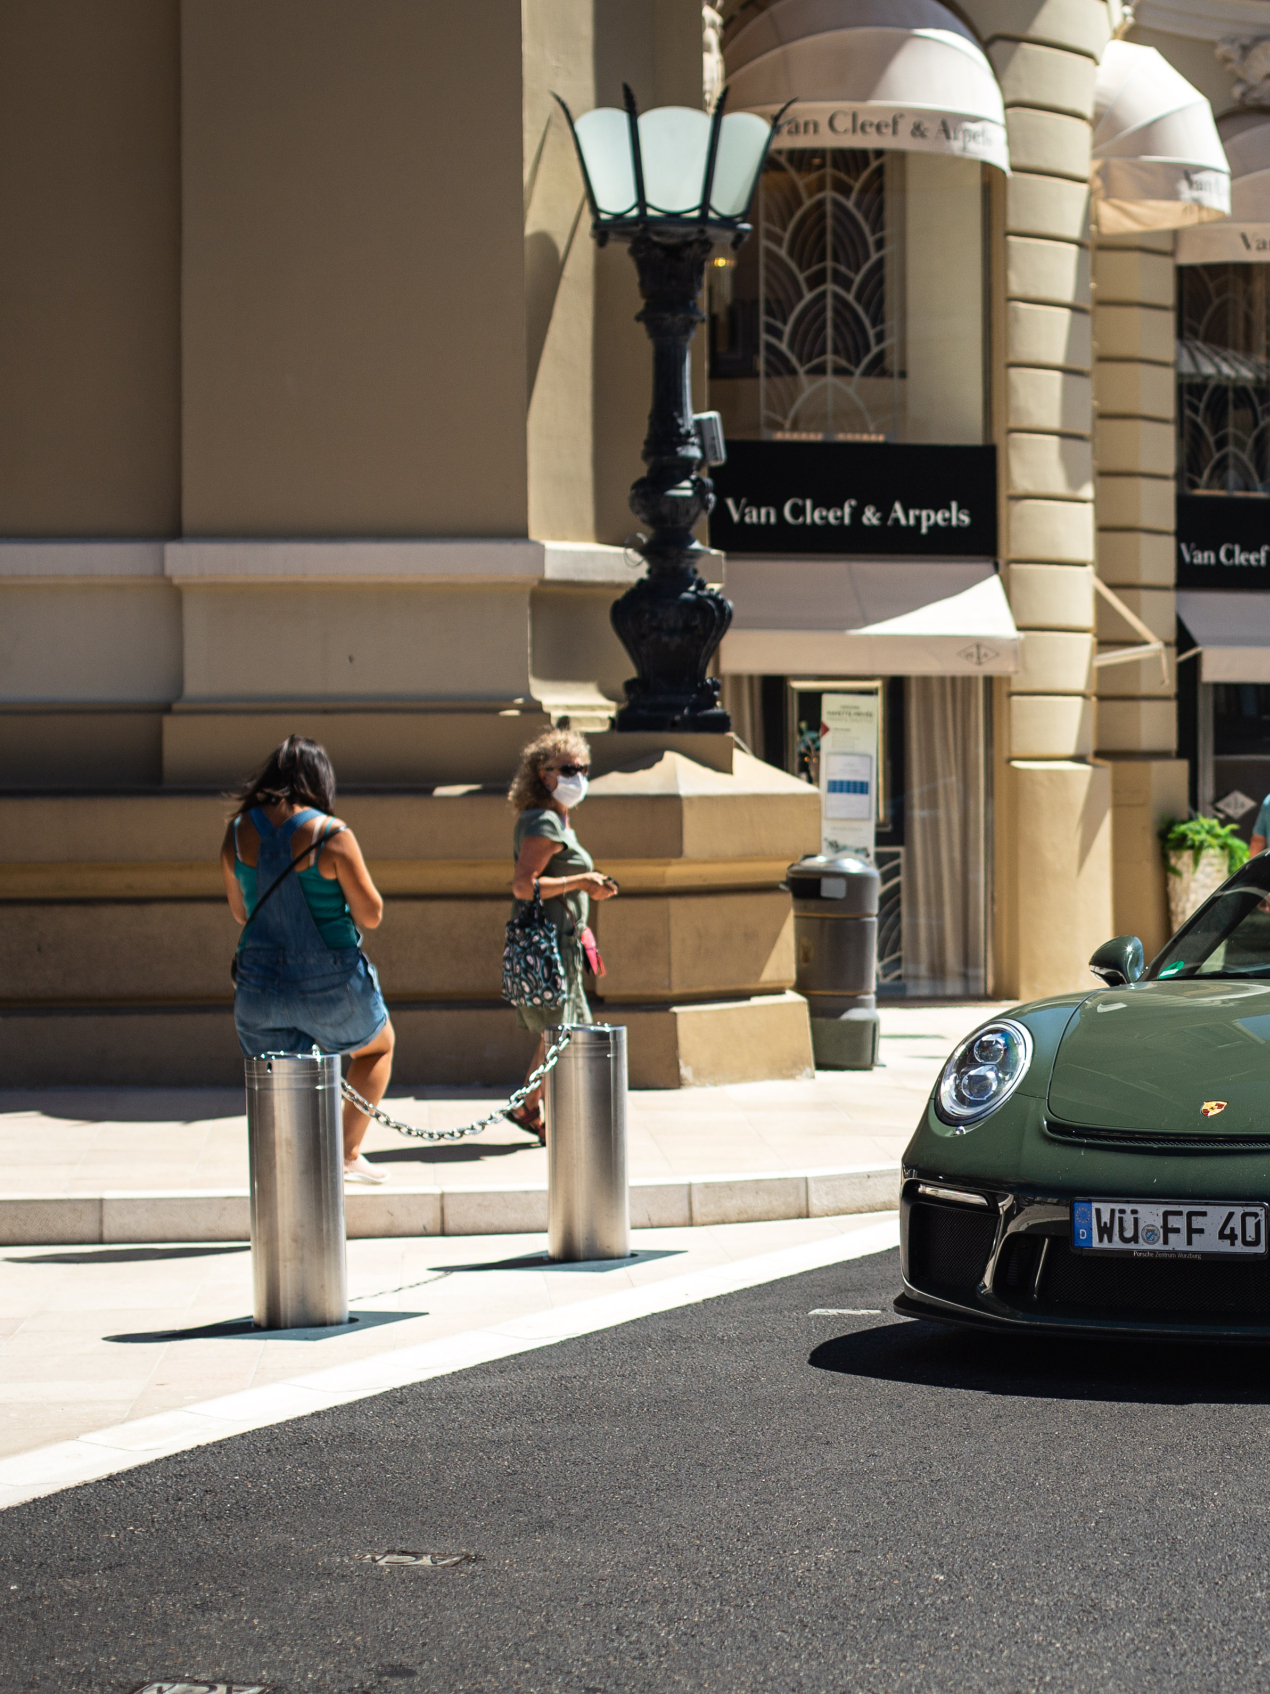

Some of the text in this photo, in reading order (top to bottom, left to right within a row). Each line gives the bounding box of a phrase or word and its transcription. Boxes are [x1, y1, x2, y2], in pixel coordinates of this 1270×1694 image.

[828, 110, 905, 137] Cleef
[909, 119, 929, 139] &
[725, 498, 971, 534] Van Cleef & Arpels
[1179, 542, 1216, 565] Van
[1219, 543, 1270, 567] Cleef
[1079, 1229, 1087, 1240] D
[1095, 1207, 1262, 1247] WÜ FF 40
[1133, 1250, 1154, 1258] Porsche
